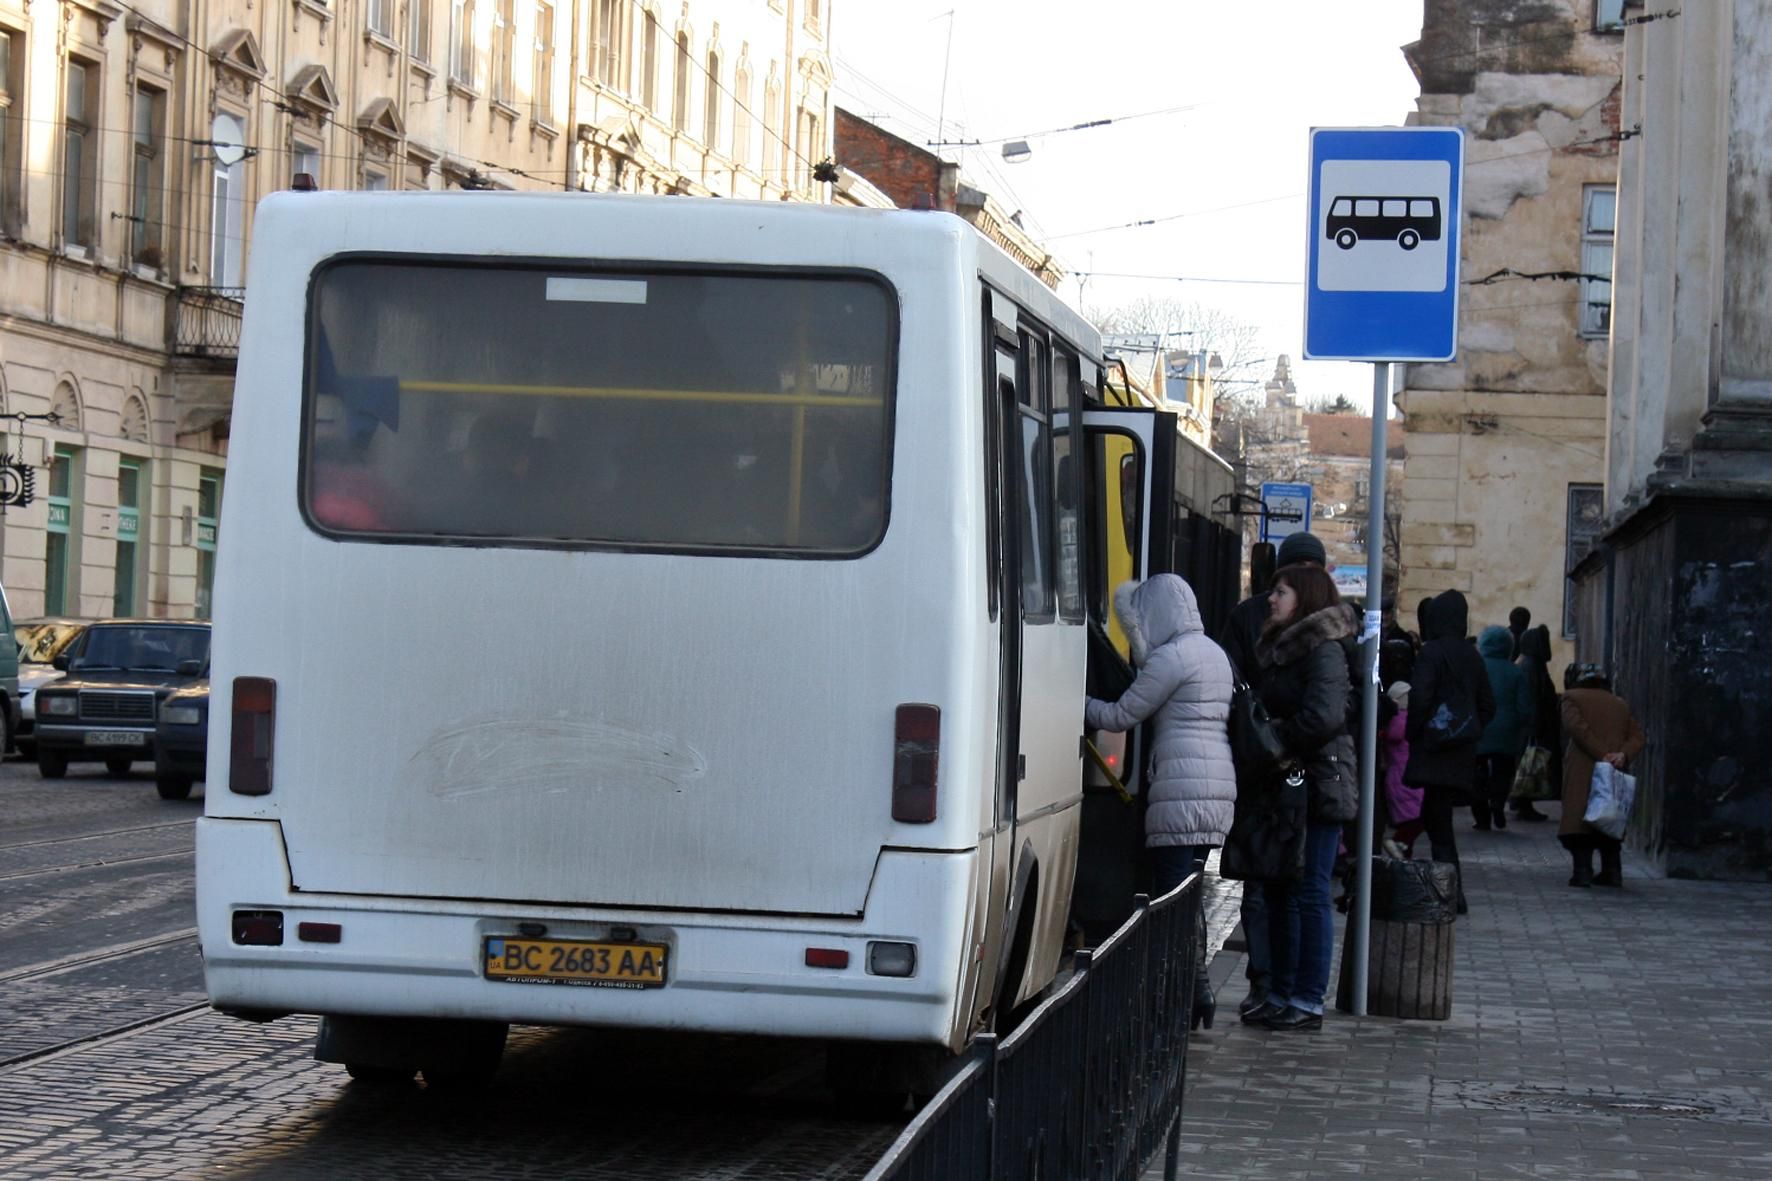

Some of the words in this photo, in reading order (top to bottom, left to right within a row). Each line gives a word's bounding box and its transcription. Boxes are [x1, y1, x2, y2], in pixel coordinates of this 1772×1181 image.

[505, 945, 542, 970] BC
[550, 948, 611, 974] 2683
[618, 951, 657, 976] AA
